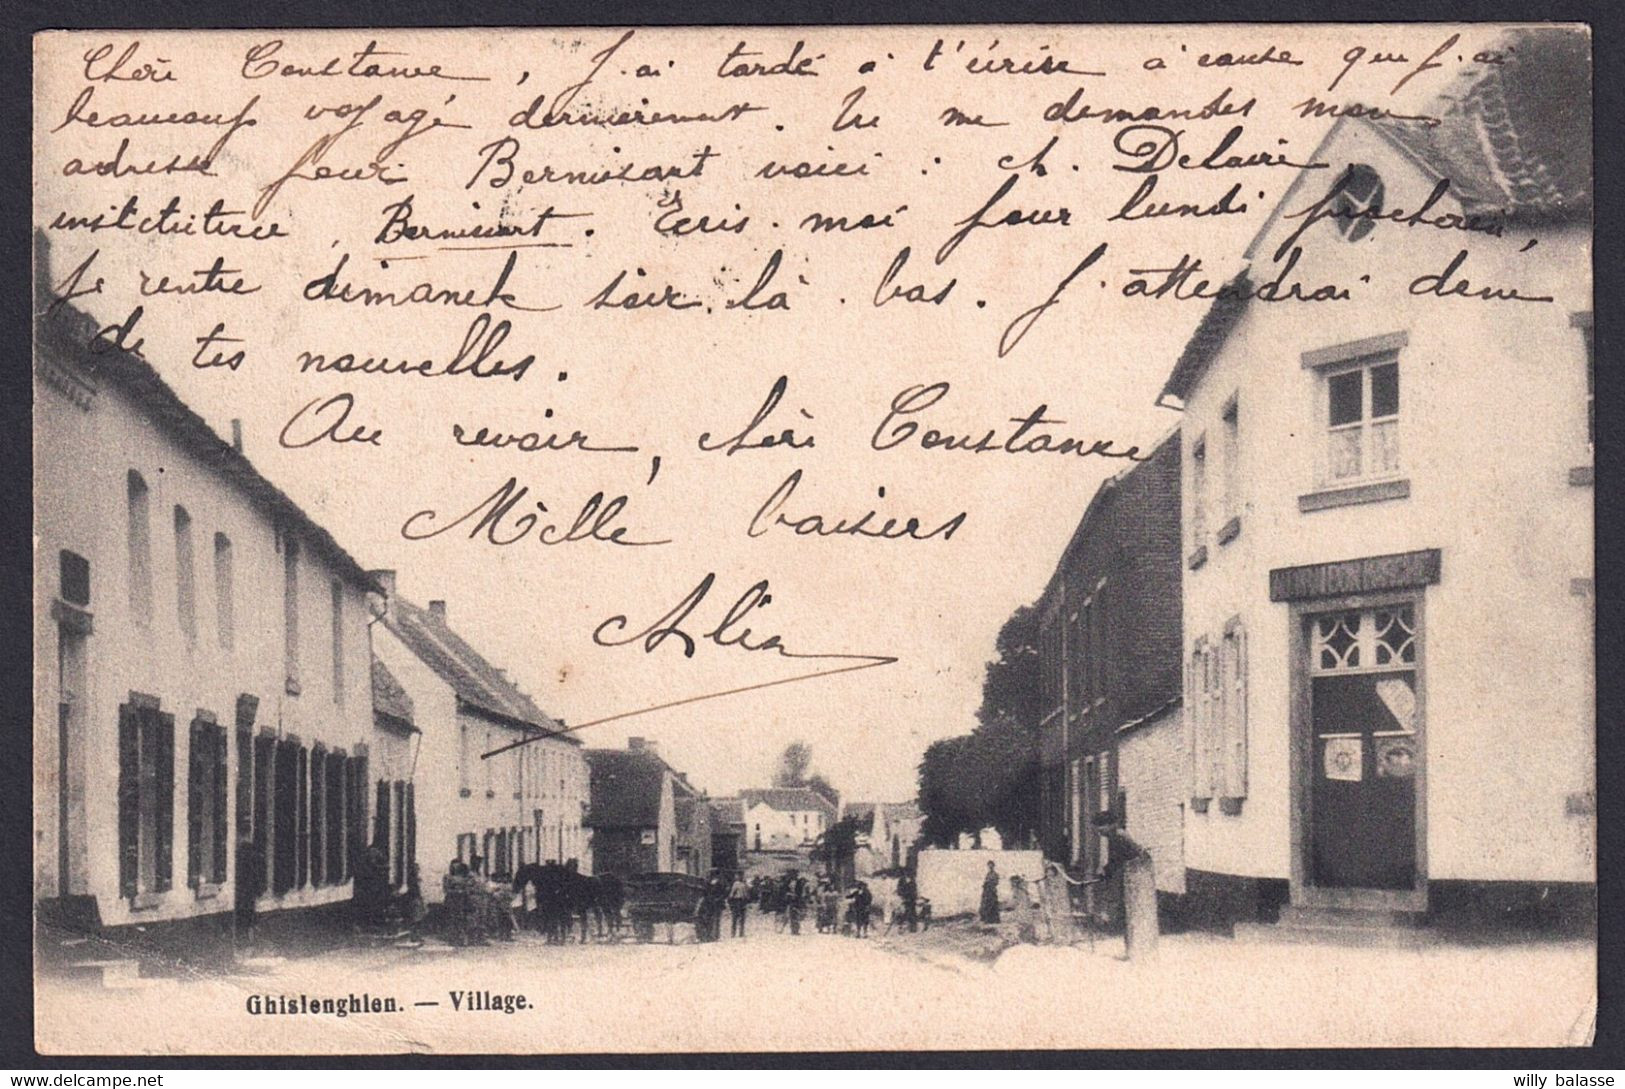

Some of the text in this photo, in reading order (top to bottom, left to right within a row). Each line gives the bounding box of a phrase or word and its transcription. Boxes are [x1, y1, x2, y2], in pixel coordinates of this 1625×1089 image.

[278, 392, 384, 449] Au
[746, 468, 968, 541] baisers
[449, 990, 534, 1014] Village.
